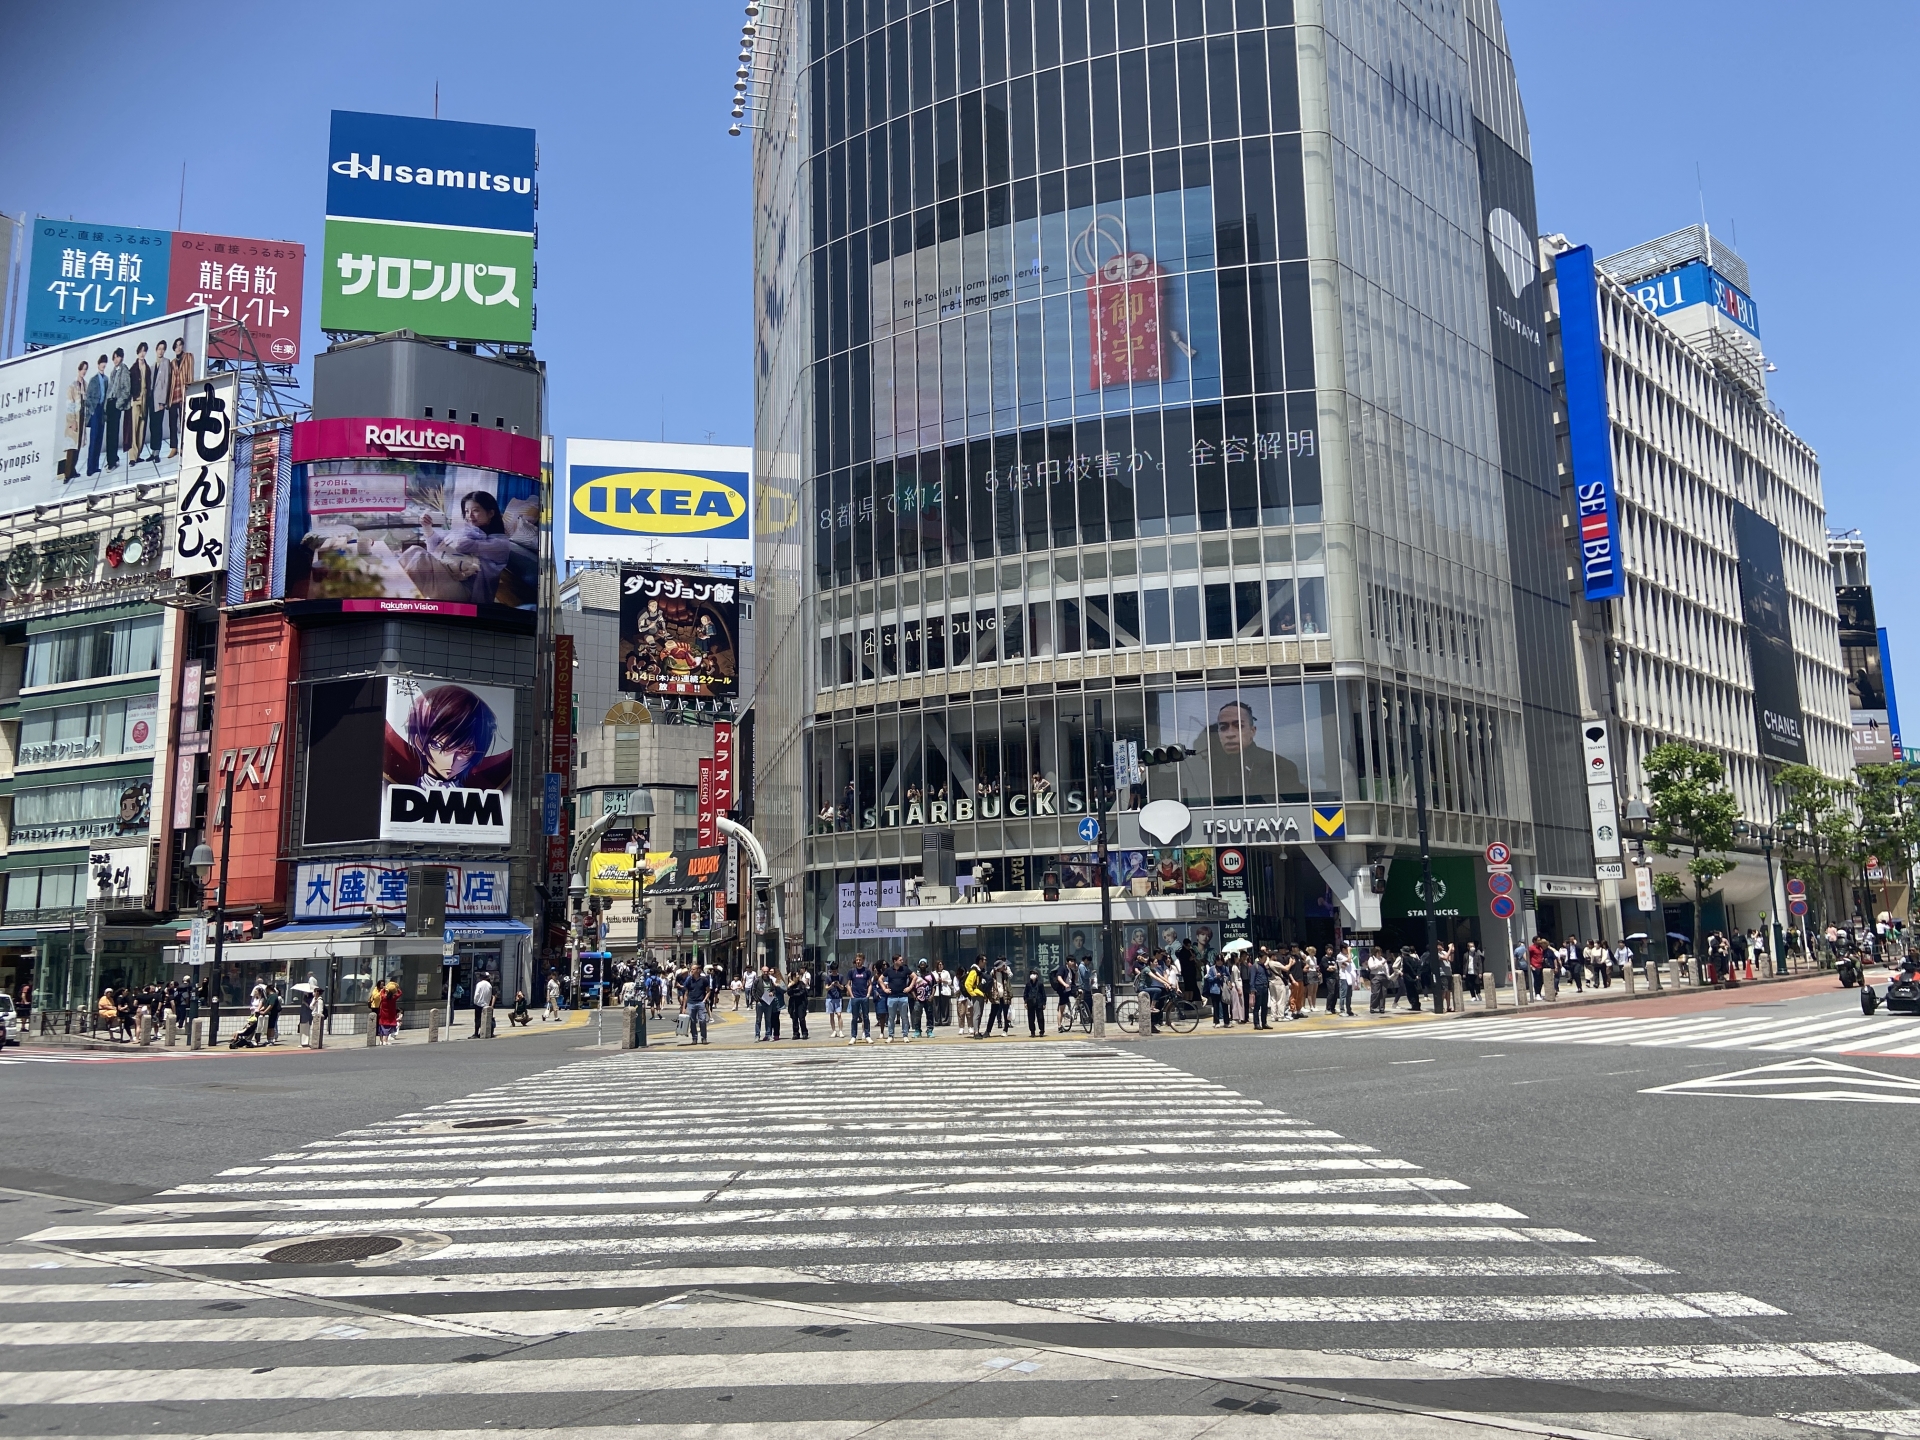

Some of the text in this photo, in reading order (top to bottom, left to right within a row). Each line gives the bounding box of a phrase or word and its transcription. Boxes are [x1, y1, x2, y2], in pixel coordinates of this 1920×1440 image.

[331, 152, 531, 194] Hisamitsu
[43, 227, 163, 247] のど、直接、うるおう
[181, 239, 297, 260] のど、直接、うるおう
[61, 248, 144, 283] 龍角散
[200, 260, 278, 295] 龍角散
[337, 252, 520, 308] サロンパス
[47, 280, 155, 316] ダイレクト
[949, 299, 955, 310] 8
[1714, 278, 1756, 331] SEIBU
[57, 315, 100, 325] スティック
[1109, 291, 1144, 365] 御守
[1496, 305, 1541, 347] TSUTAYA
[273, 344, 294, 354] 生薬
[365, 425, 465, 451] Rakuten
[1188, 429, 1315, 468] 全容解明
[178, 382, 231, 568] もんじゃ
[313, 478, 352, 487] オフの日は、
[313, 496, 401, 507] 永遠に楽しめちゃうんです。
[1578, 481, 1613, 582] SEIBU
[380, 601, 438, 611] Rakuten Vision
[623, 574, 735, 605] ダンジョン飯
[884, 615, 1007, 646] SHARE LOUNGE
[557, 639, 569, 726] クスリのことなら
[1763, 709, 1802, 739] CHANEL
[715, 731, 730, 800] カラオケ
[701, 767, 709, 805] BIG ECHO
[390, 788, 504, 826] DMM
[862, 790, 1084, 829] STARBUCKS
[700, 812, 711, 848] カラ
[1202, 816, 1299, 834] TSUTAYA
[1224, 857, 1239, 866] LDH
[1606, 865, 1620, 873] 400
[306, 871, 496, 906] 大盛堂店
[1407, 909, 1459, 917] STAUCKS
